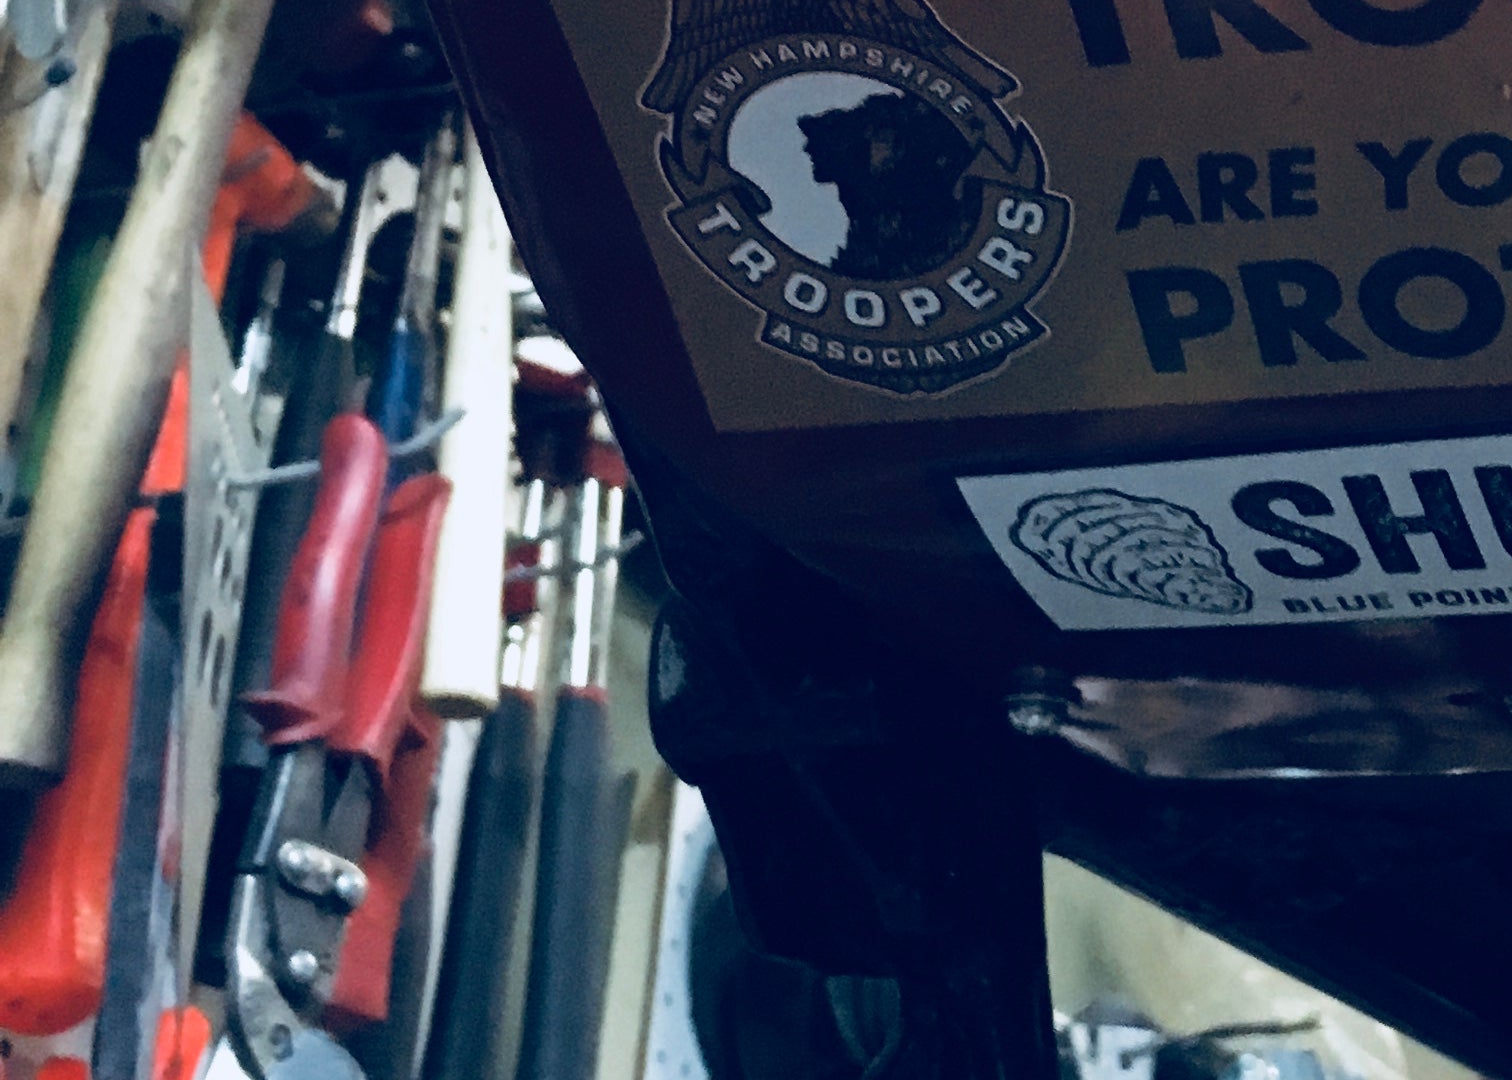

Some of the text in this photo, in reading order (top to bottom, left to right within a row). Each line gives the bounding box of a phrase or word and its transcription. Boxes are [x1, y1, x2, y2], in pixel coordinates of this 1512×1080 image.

[693, 38, 974, 126] NEW HAMPSHIRE
[1115, 146, 1319, 232] ARE
[698, 195, 1045, 328] TROOPERS
[769, 318, 1031, 368] ASSOCIATION
[1282, 590, 1395, 614] BLUE
